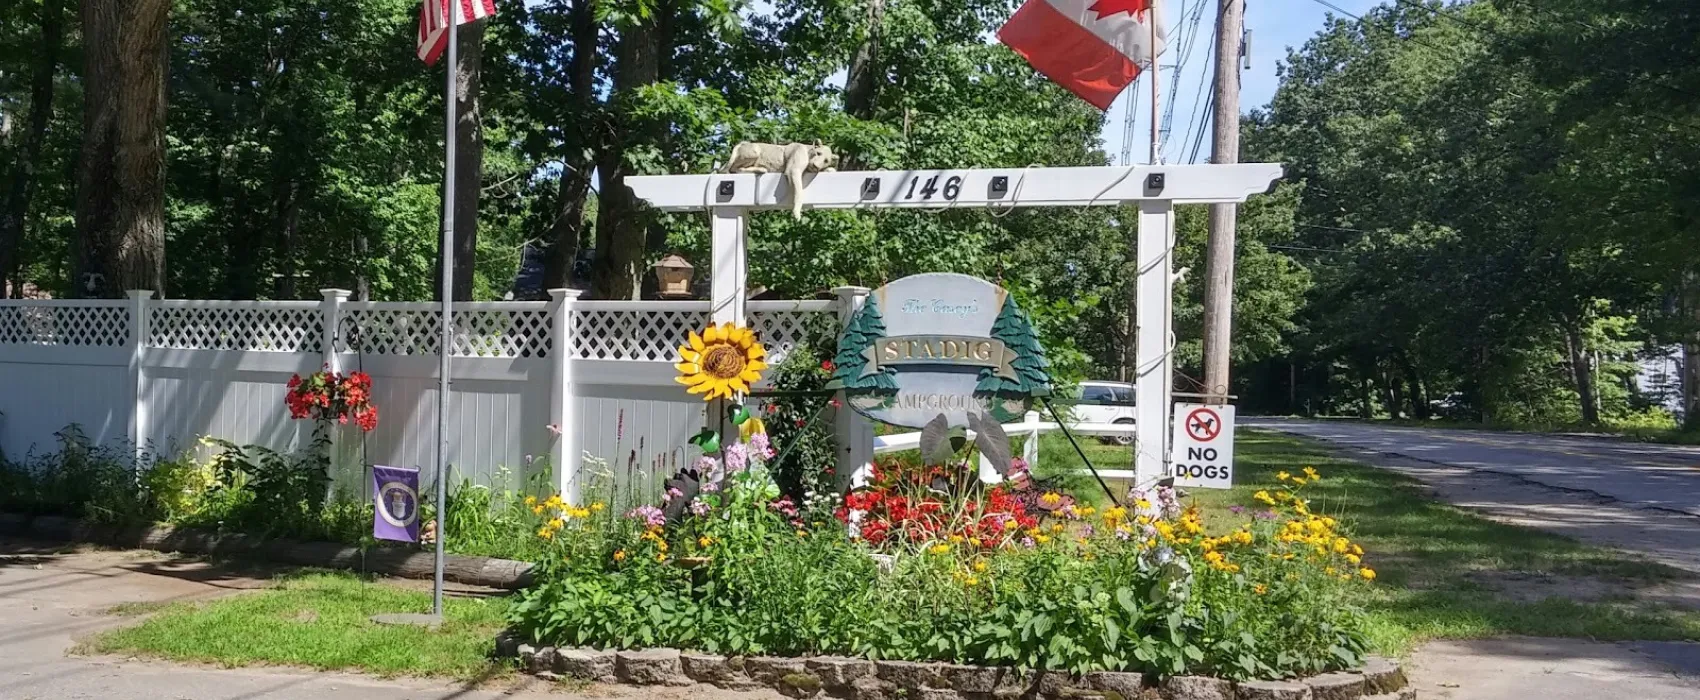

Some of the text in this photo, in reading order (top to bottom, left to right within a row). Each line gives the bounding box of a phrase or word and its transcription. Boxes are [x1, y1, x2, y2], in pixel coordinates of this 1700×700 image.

[904, 175, 961, 200] 146
[901, 298, 927, 314] The
[884, 340, 993, 361] STADIG
[1188, 447, 1218, 461] NO
[1176, 464, 1229, 479] DOGS
